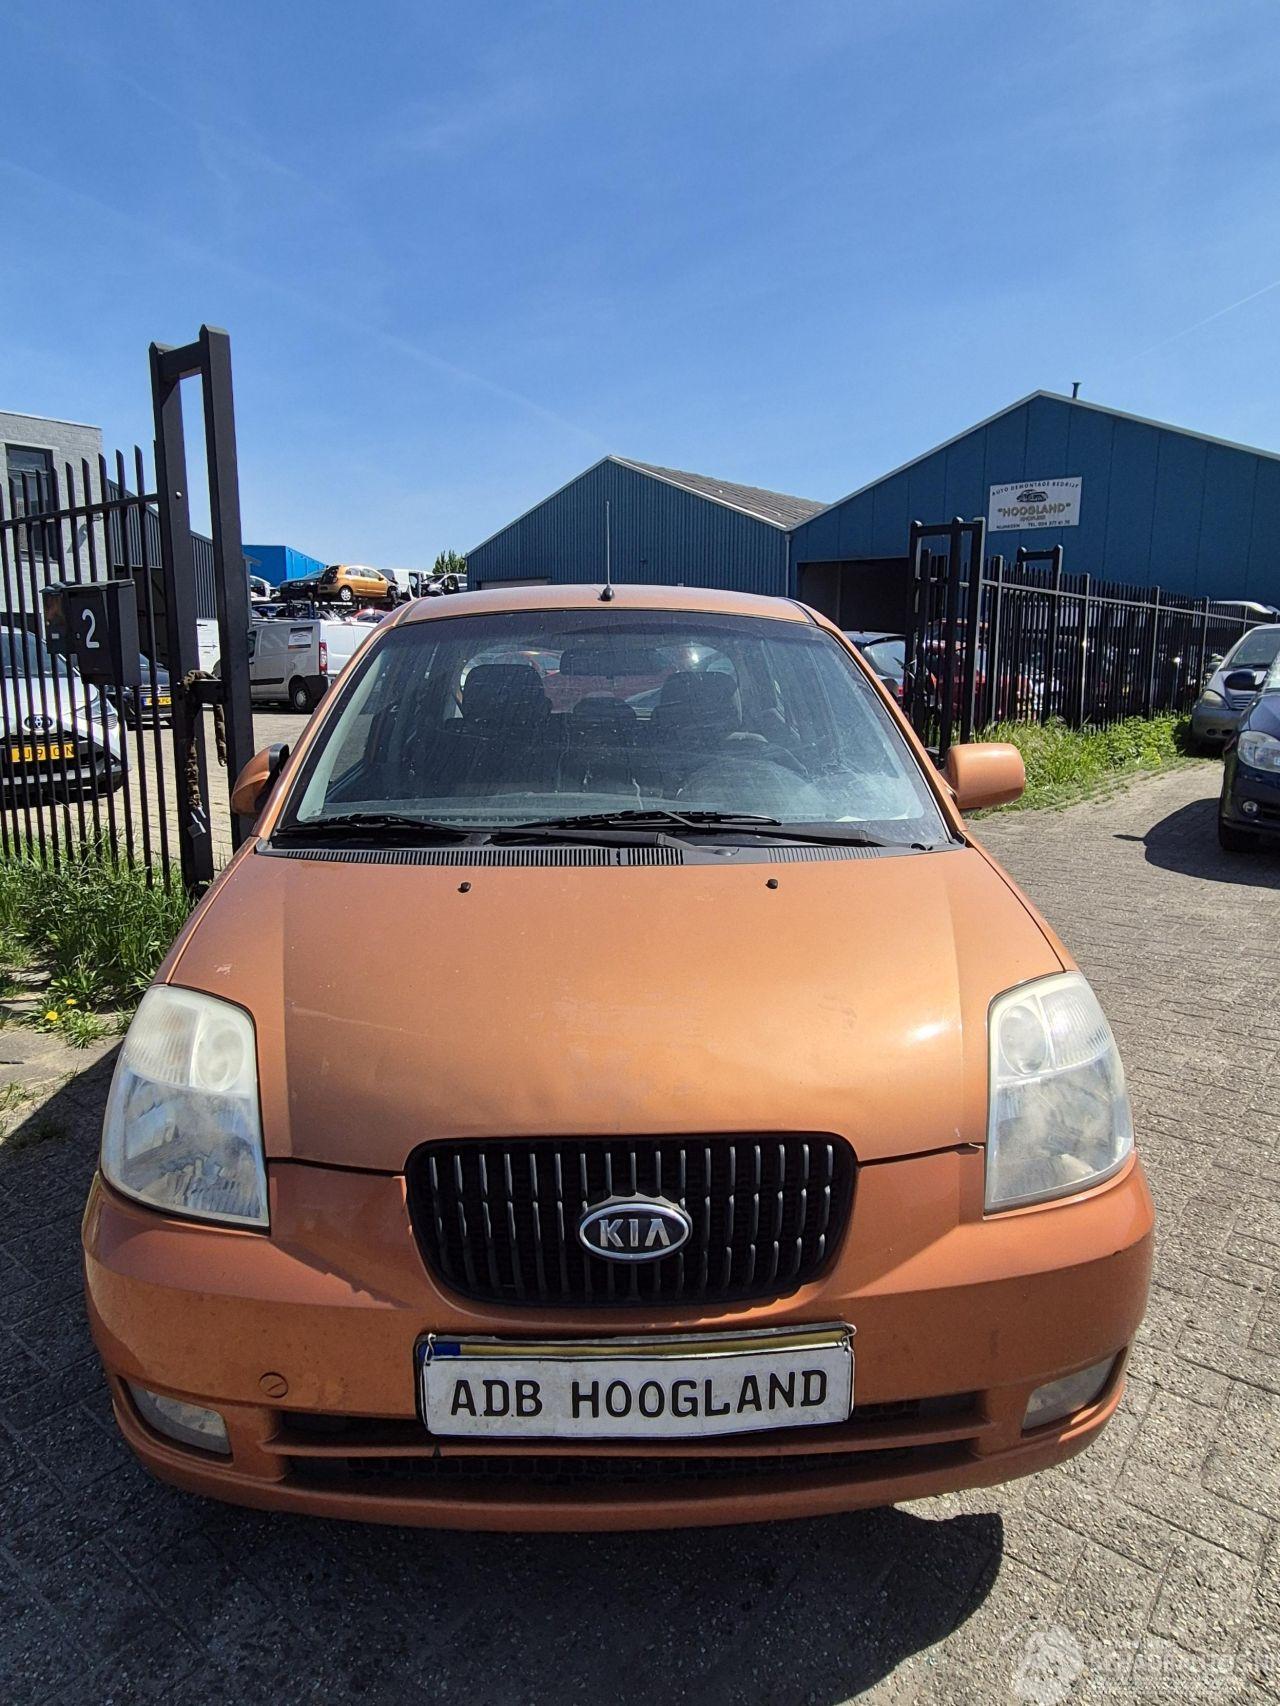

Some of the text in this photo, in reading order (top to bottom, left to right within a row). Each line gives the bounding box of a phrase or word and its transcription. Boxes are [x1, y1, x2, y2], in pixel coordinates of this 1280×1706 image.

[992, 487, 1009, 496] AUTO
[1010, 481, 1050, 490] DEMONTAGE
[81, 608, 100, 649] 2
[598, 1218, 671, 1248] KIA
[571, 1369, 828, 1419] HOOGLAND
